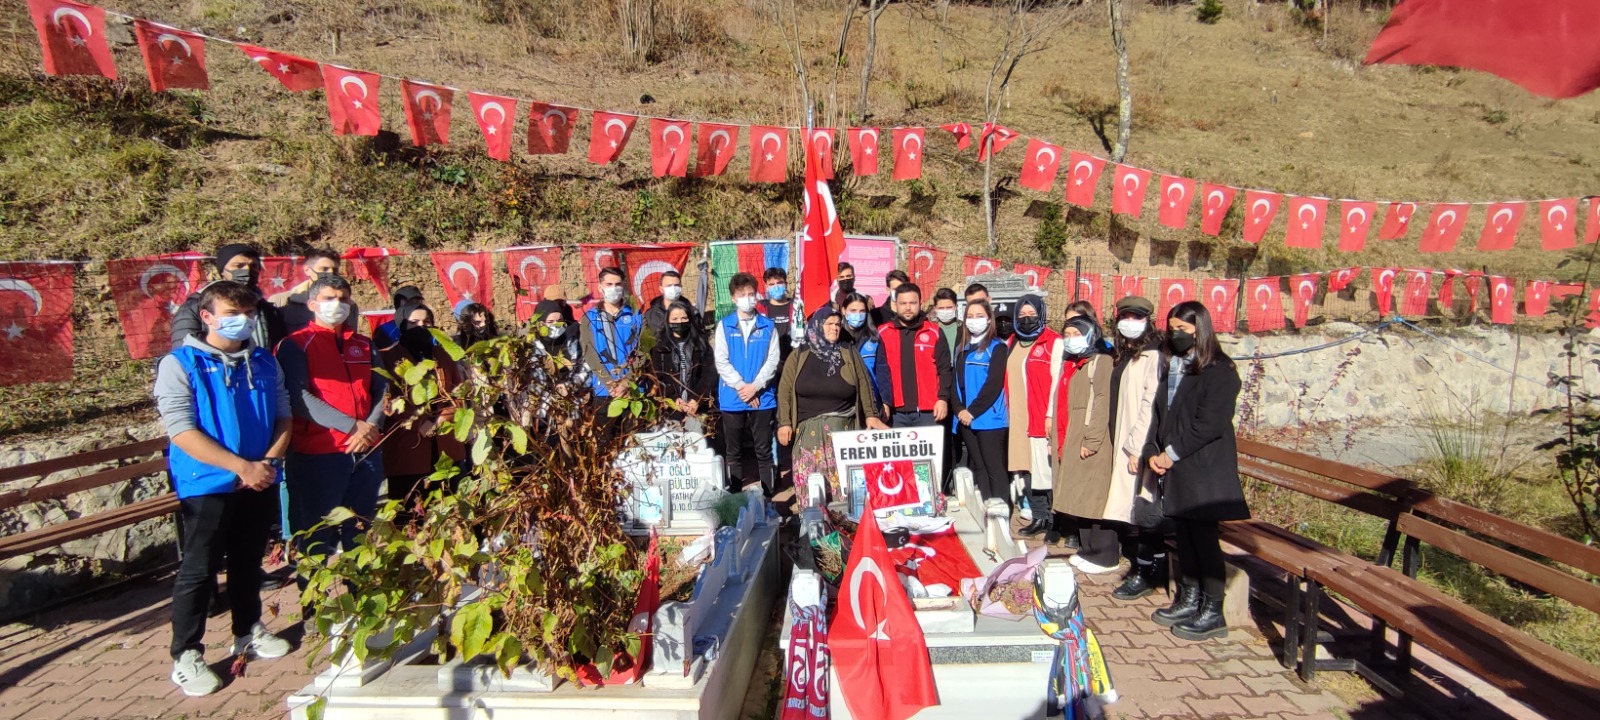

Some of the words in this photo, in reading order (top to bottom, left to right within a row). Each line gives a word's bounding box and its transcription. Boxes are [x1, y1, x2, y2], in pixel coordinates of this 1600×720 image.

[871, 430, 902, 442] ŞEHİT
[840, 446, 877, 460] EREN
[882, 441, 936, 458] BÜLBÜL
